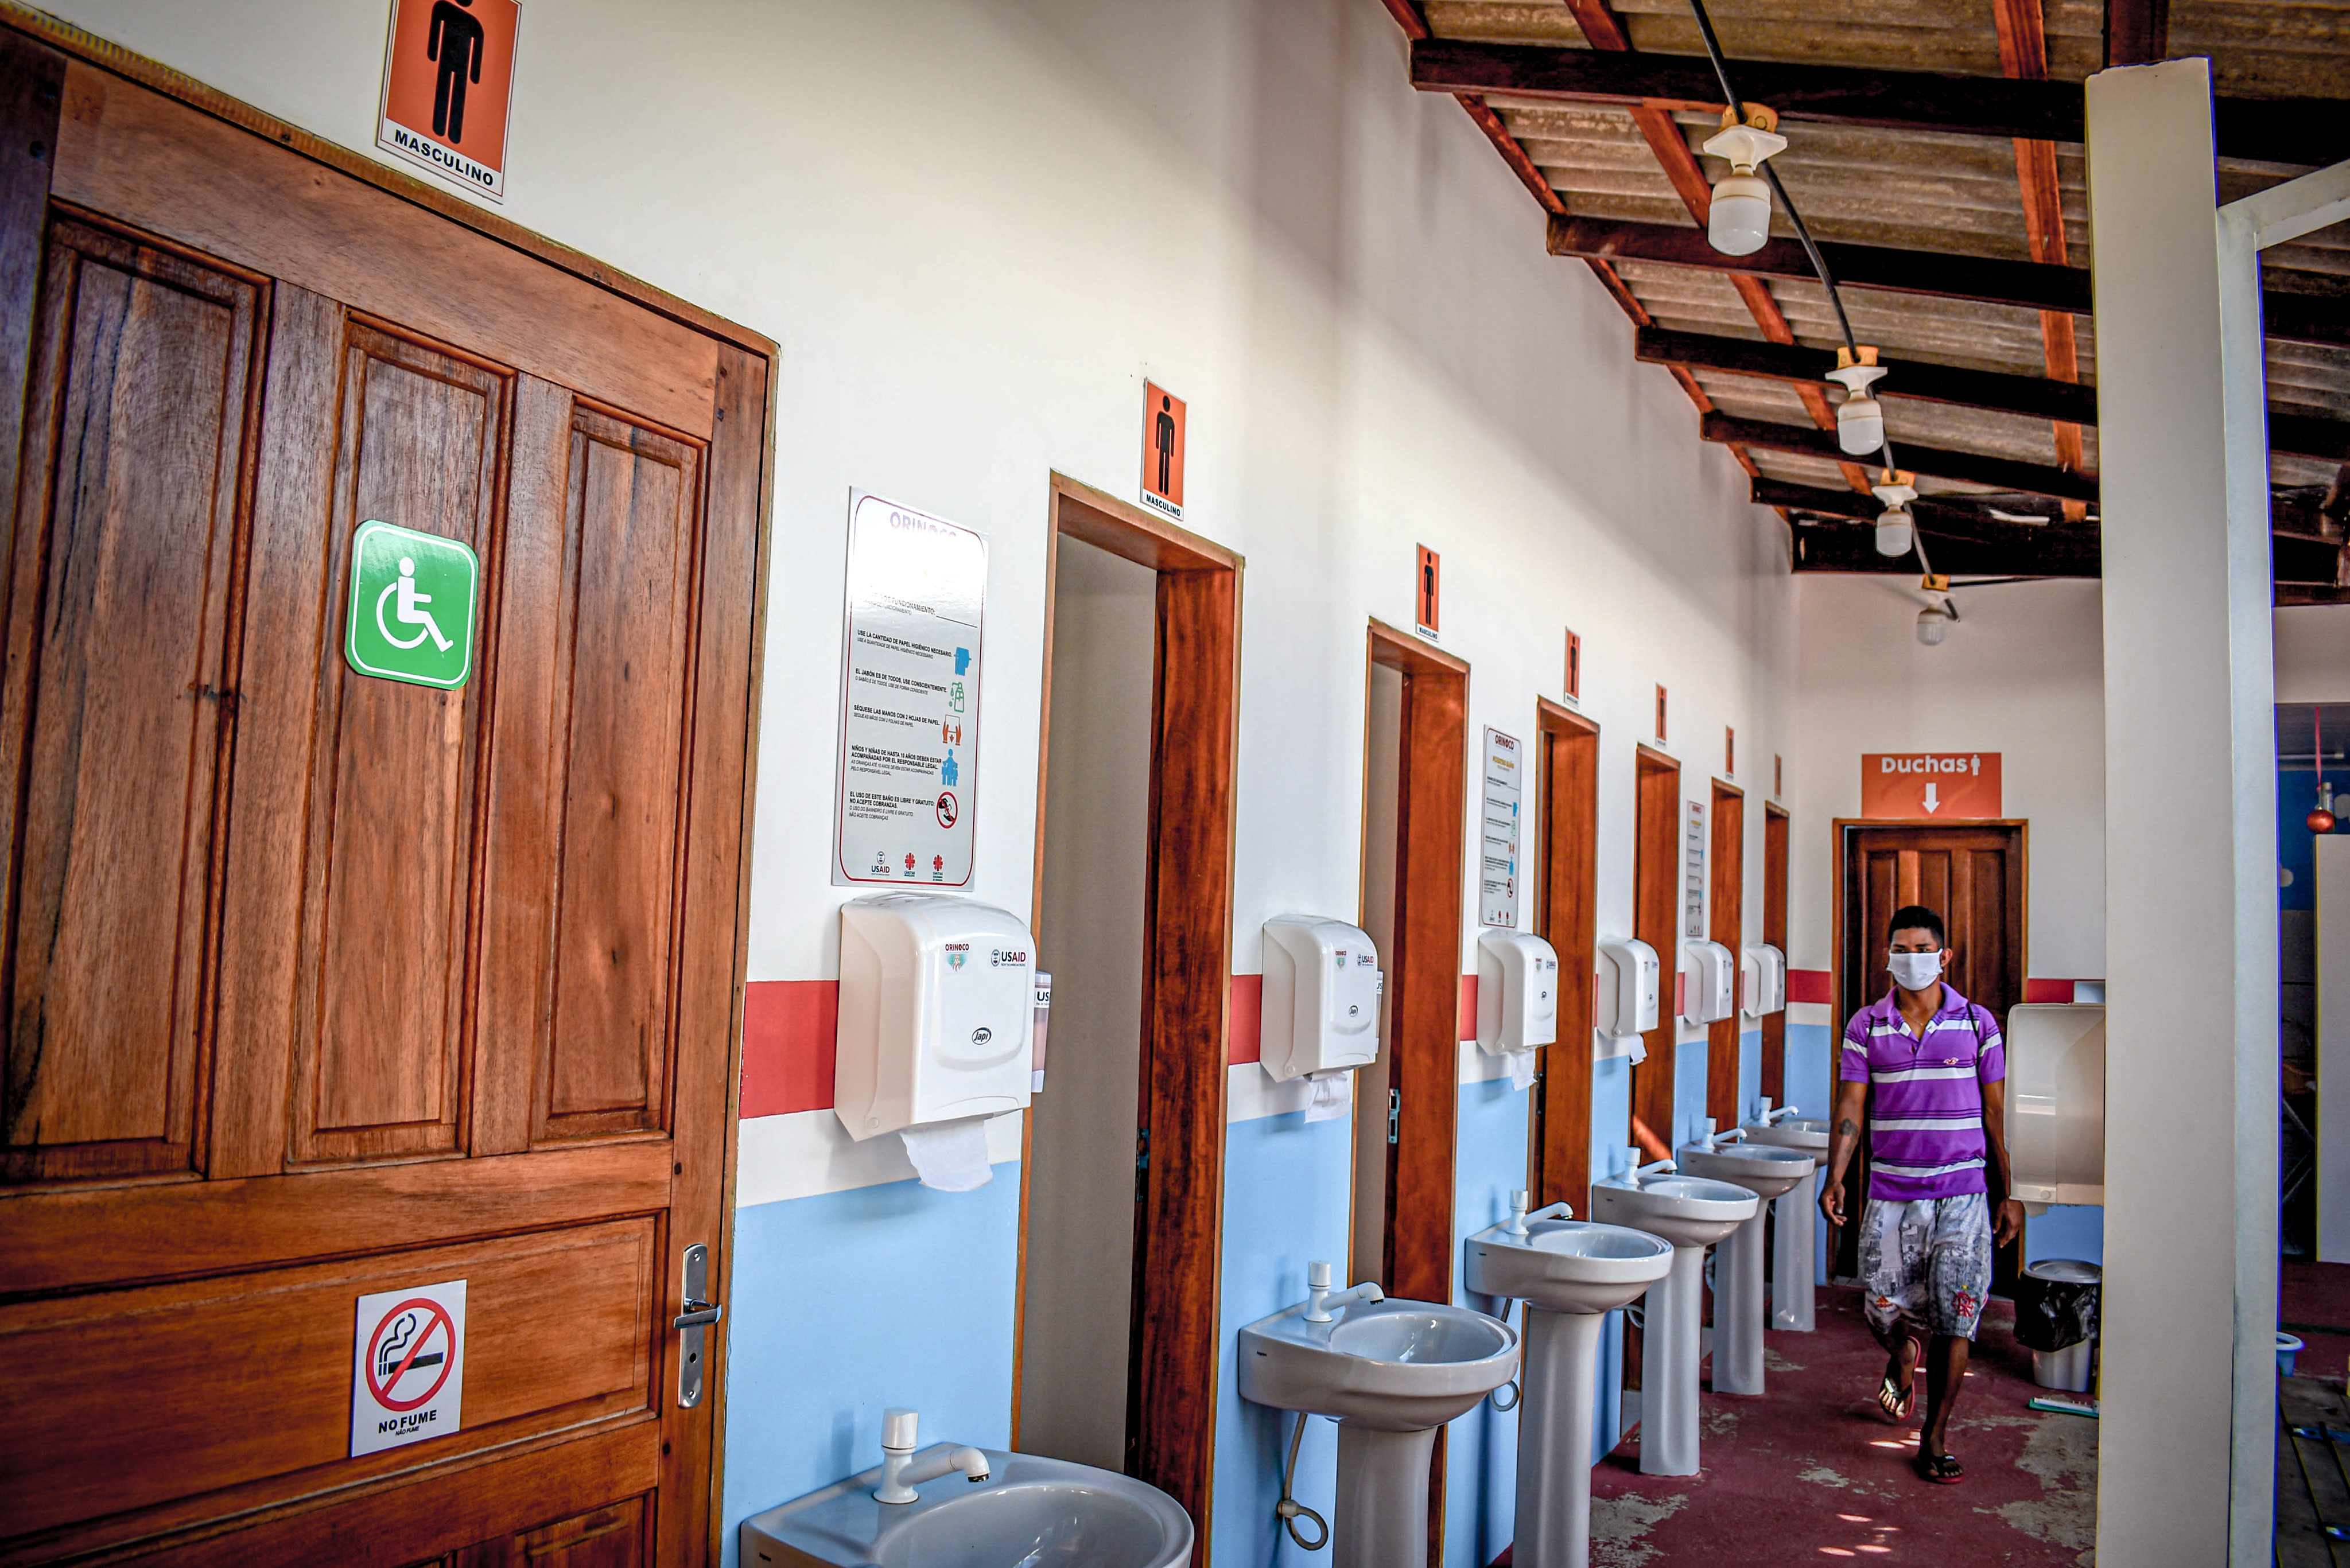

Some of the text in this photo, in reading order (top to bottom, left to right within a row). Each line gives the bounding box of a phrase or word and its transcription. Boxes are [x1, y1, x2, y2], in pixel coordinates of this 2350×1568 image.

[394, 129, 494, 186] MASCULINO
[1146, 494, 1180, 516] MASCULINO
[1419, 627, 1438, 640] MASCULINO
[872, 633, 892, 643] CANTIDAD
[912, 643, 930, 652] HIGIÉNICO
[861, 670, 875, 678] JABÓN
[854, 705, 872, 713] SÉQUESE
[1495, 734, 1514, 750] ORINOCO
[852, 752, 881, 761] ACOMPAÑADAS
[897, 758, 925, 767] RESPONSABLE
[1882, 754, 1968, 773] Duchas
[871, 865, 890, 873] USAID
[945, 943, 969, 951] ORINOCO
[1001, 951, 1026, 962] USAID
[974, 1032, 989, 1042] Japi
[378, 1410, 437, 1433] NO FUME
[395, 1427, 406, 1436] NÃO
